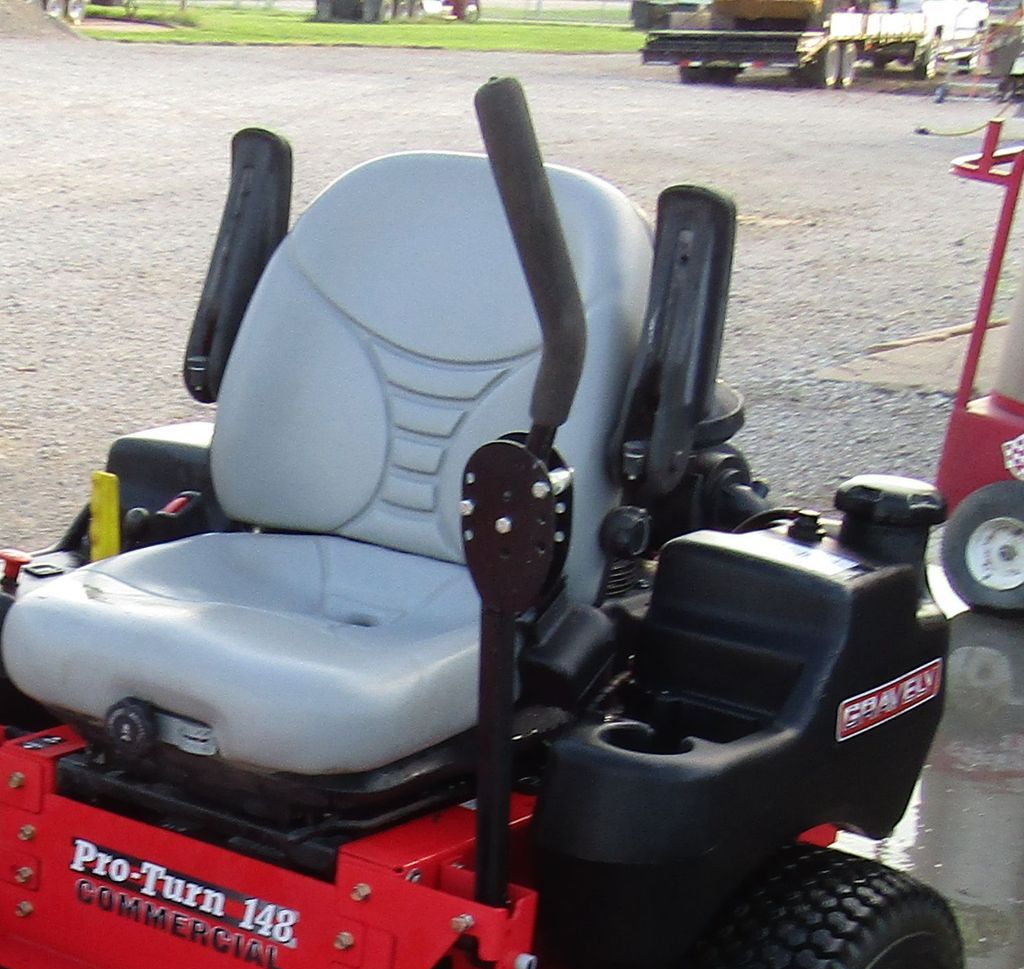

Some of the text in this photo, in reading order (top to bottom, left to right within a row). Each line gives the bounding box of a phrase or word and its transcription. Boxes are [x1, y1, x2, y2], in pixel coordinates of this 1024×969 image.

[842, 668, 937, 730] GRAVELY
[70, 838, 301, 949] Pro-Turn 148
